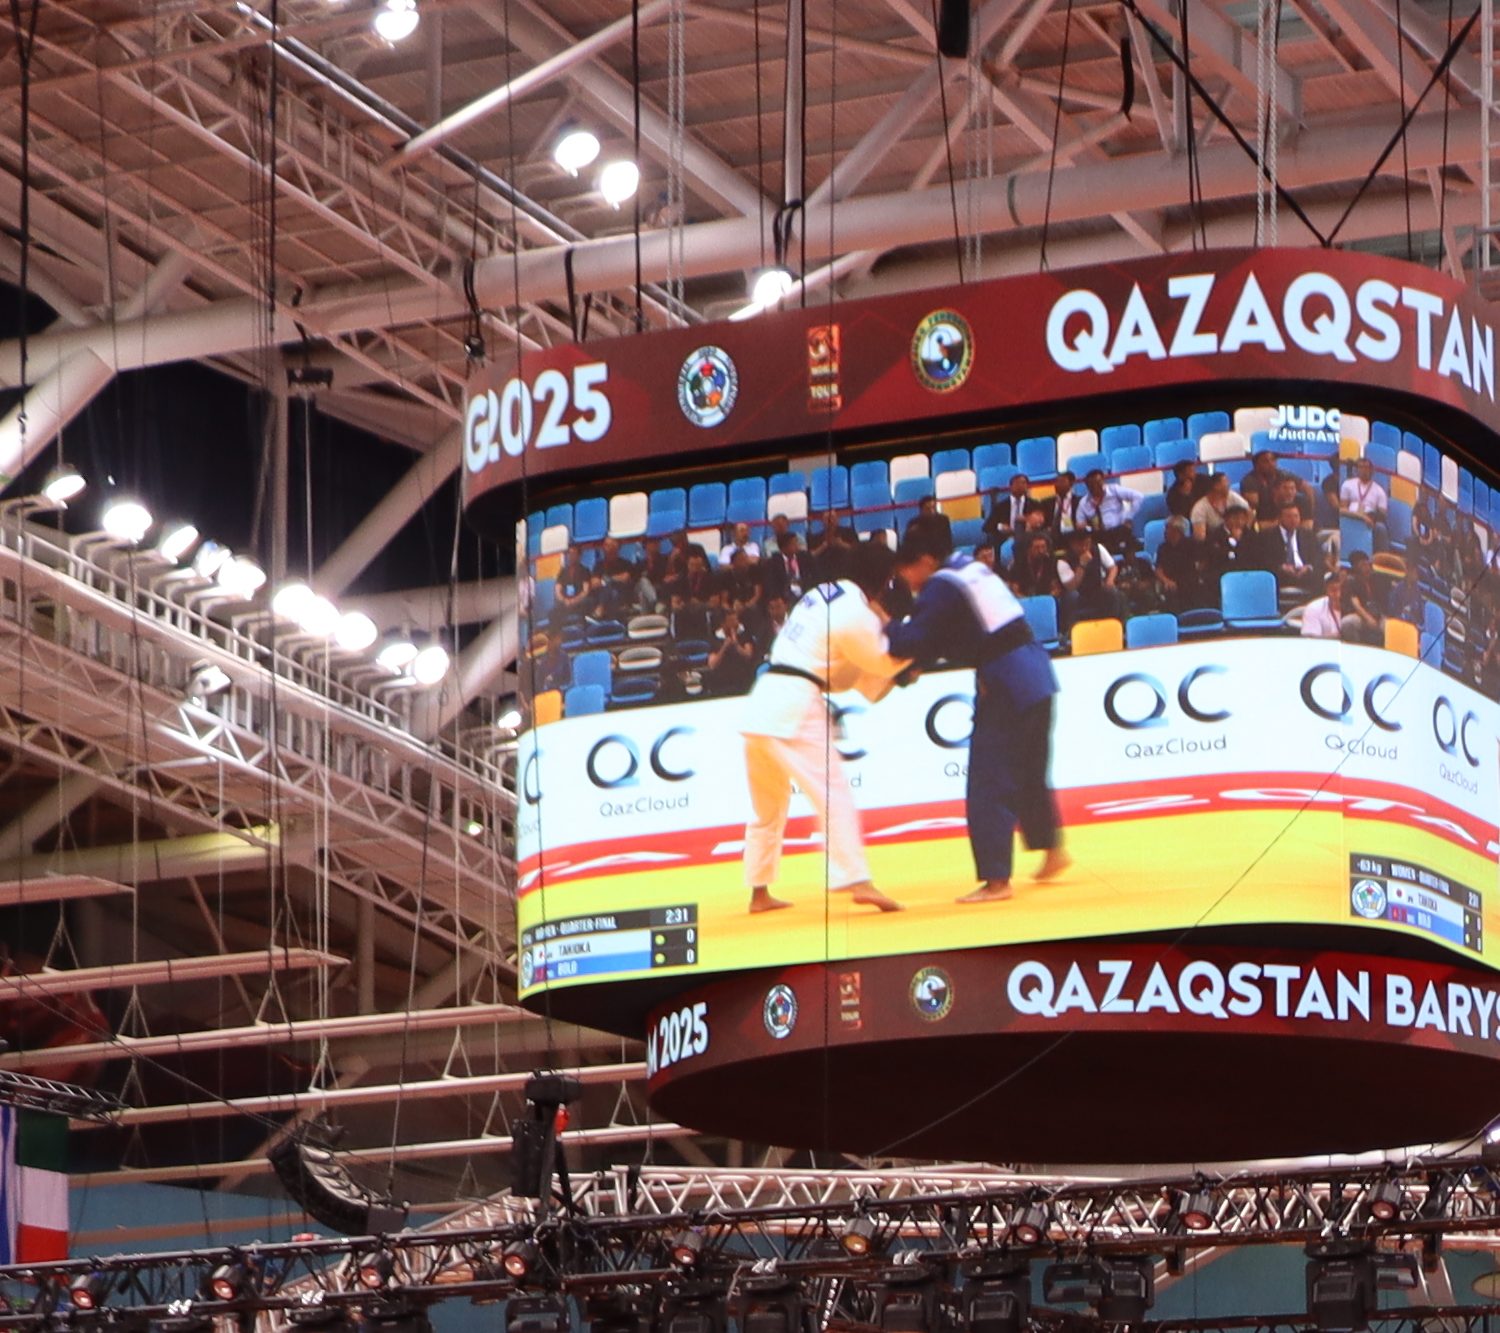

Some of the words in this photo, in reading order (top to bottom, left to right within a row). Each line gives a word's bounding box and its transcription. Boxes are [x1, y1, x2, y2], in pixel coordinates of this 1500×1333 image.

[1046, 270, 1495, 403] QAZAQSTAN
[1125, 735, 1226, 759] QazCloud
[600, 794, 689, 818] QazCloud
[1007, 960, 1369, 1022] QAZAQSTAN
[660, 1002, 708, 1068] 2025
